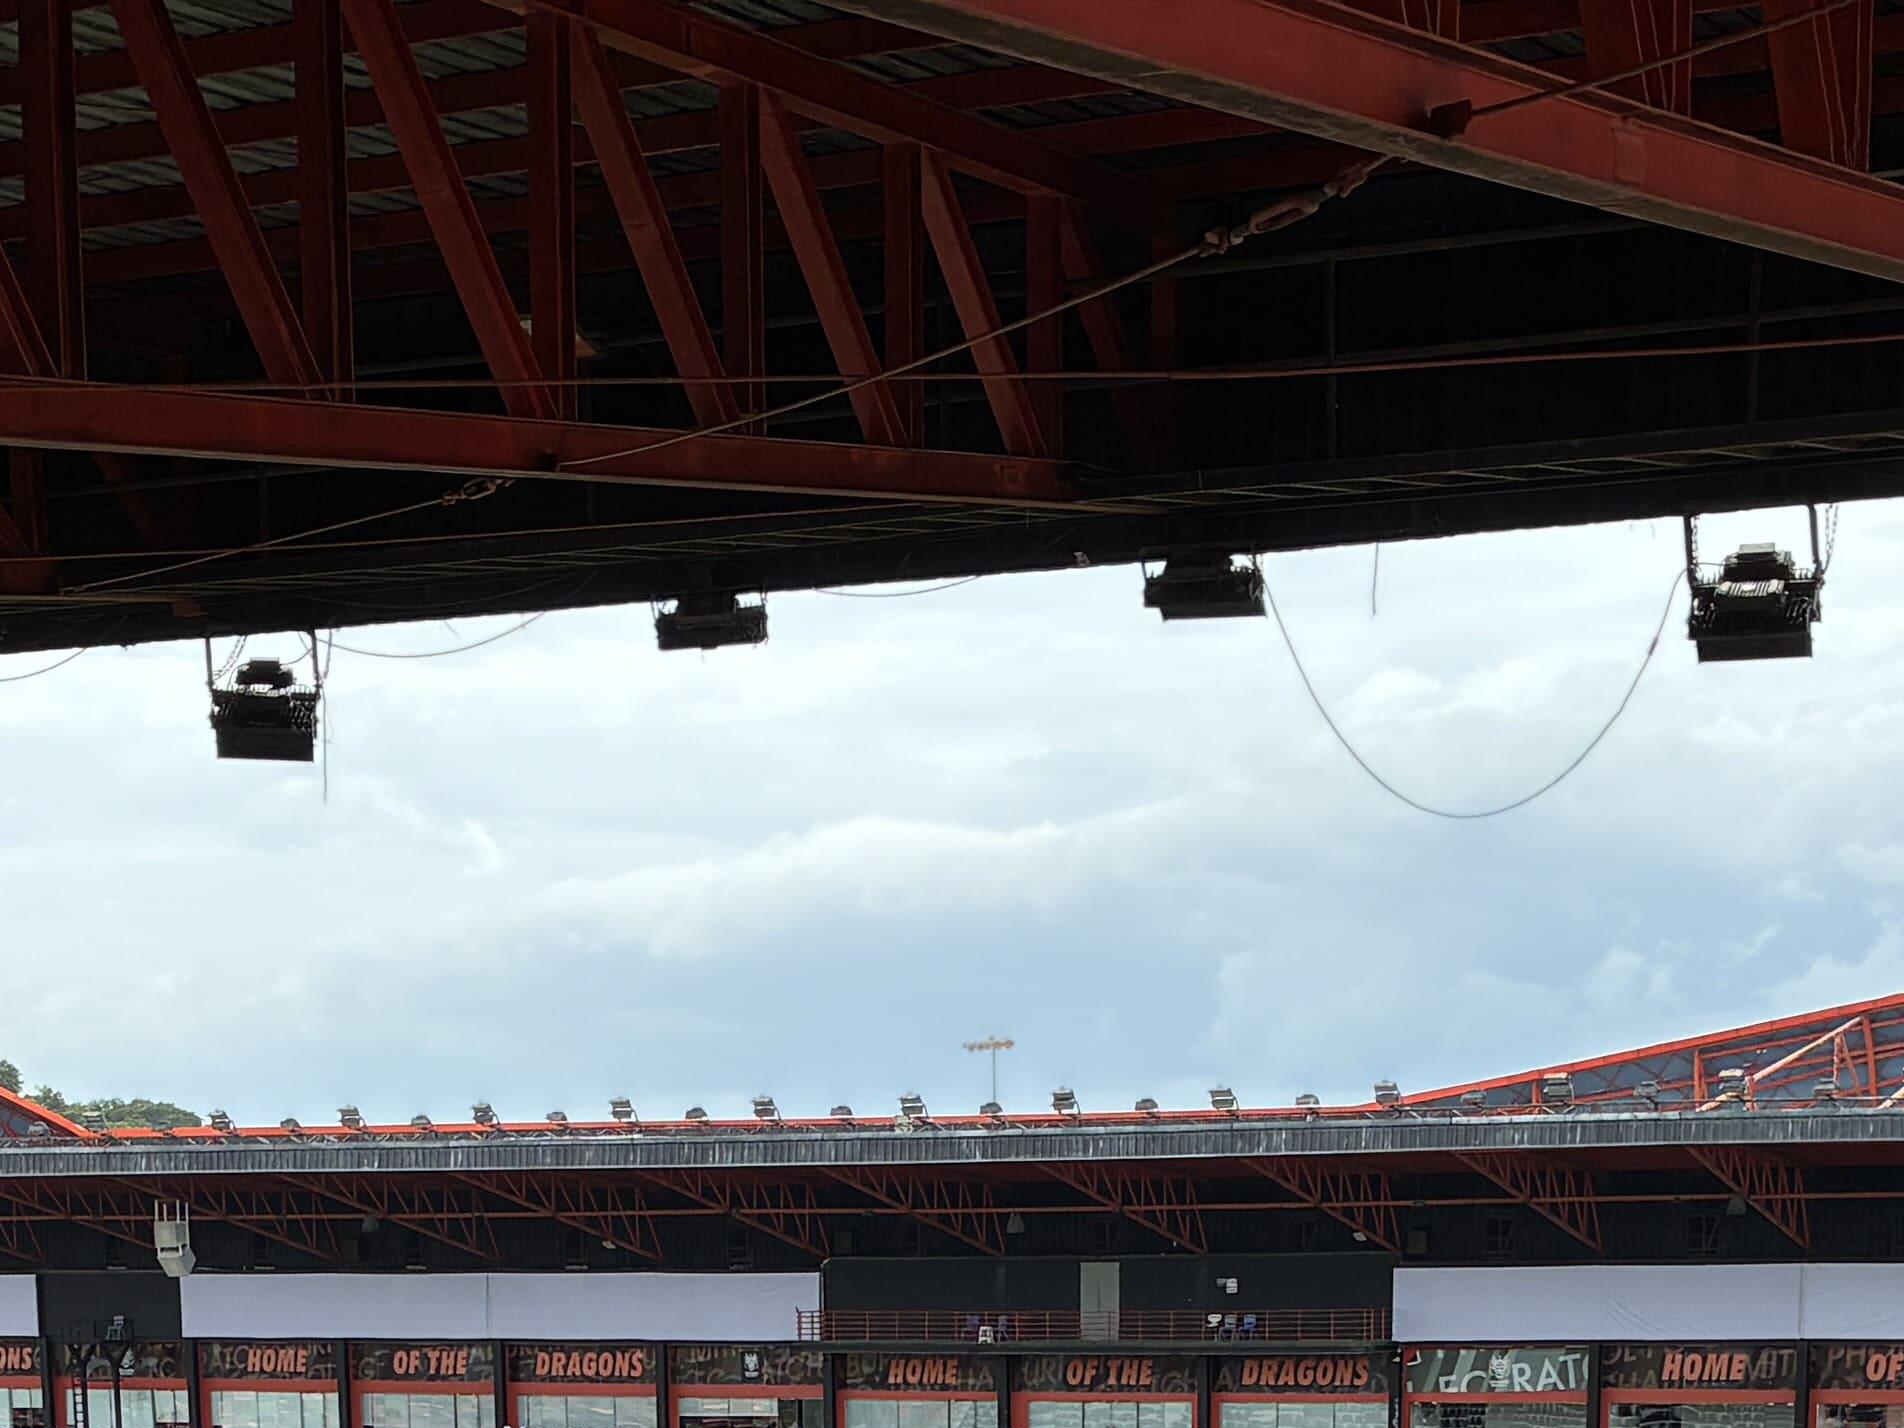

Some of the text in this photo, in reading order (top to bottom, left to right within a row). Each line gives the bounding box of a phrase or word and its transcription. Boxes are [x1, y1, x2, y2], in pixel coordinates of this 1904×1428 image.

[247, 1349, 307, 1374] HOME
[393, 1351, 420, 1376] OF
[427, 1351, 467, 1375] THE
[536, 1351, 644, 1378] DRAGONS
[888, 1359, 958, 1385] HOME
[1065, 1359, 1099, 1386] OF
[1106, 1359, 1153, 1386] THE
[1240, 1357, 1370, 1387] DRAGONS
[1661, 1353, 1746, 1382] HOME
[1865, 1353, 1904, 1383] OF
